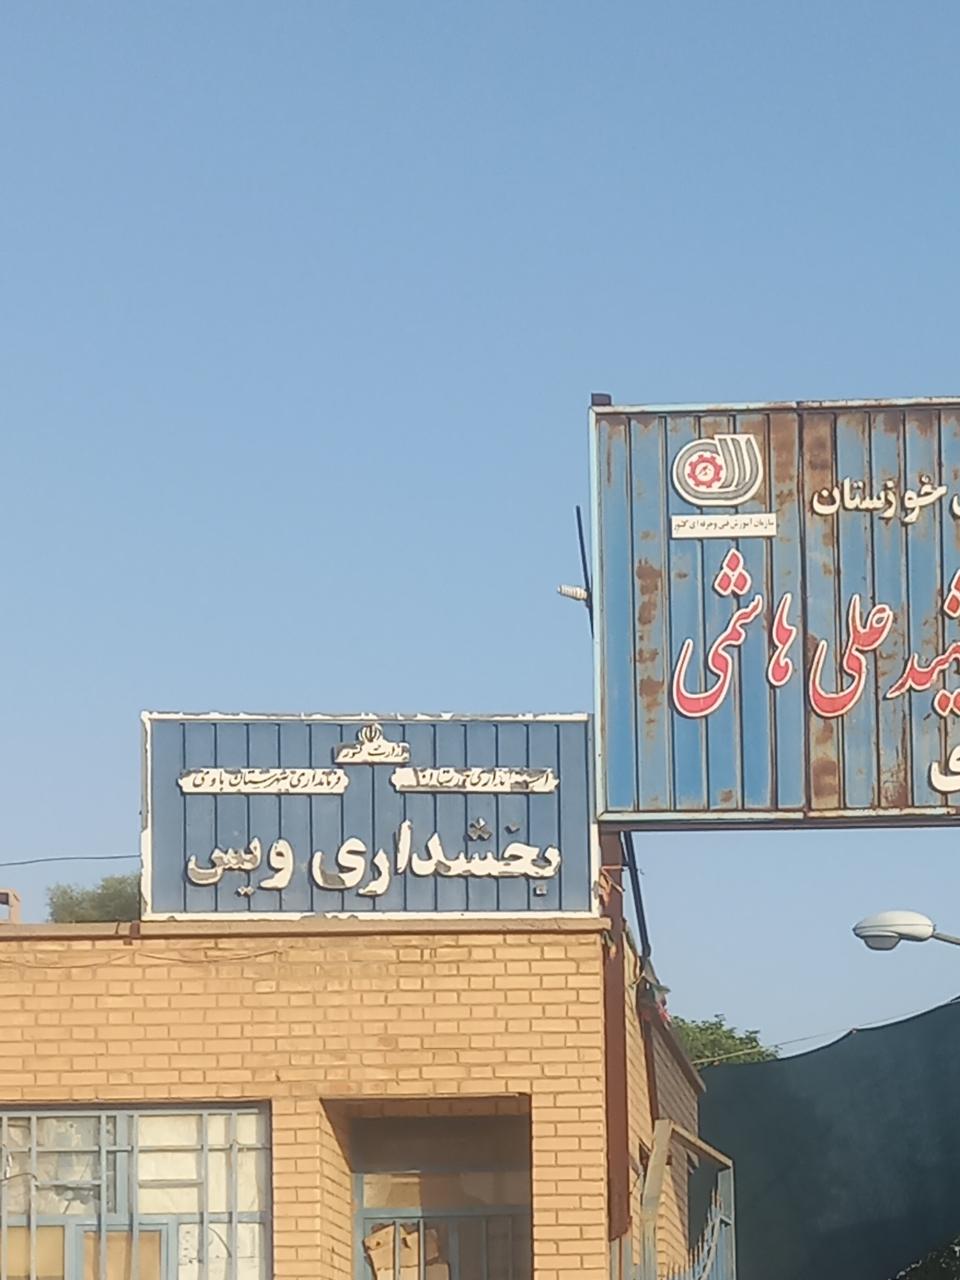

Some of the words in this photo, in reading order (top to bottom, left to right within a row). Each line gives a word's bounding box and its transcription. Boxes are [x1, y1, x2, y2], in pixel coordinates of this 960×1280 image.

[811, 474, 948, 523] خوزستان
[671, 548, 797, 718] هاشمی
[808, 592, 893, 718] علی
[186, 836, 296, 897] ویس
[310, 817, 563, 897] بخشداری
